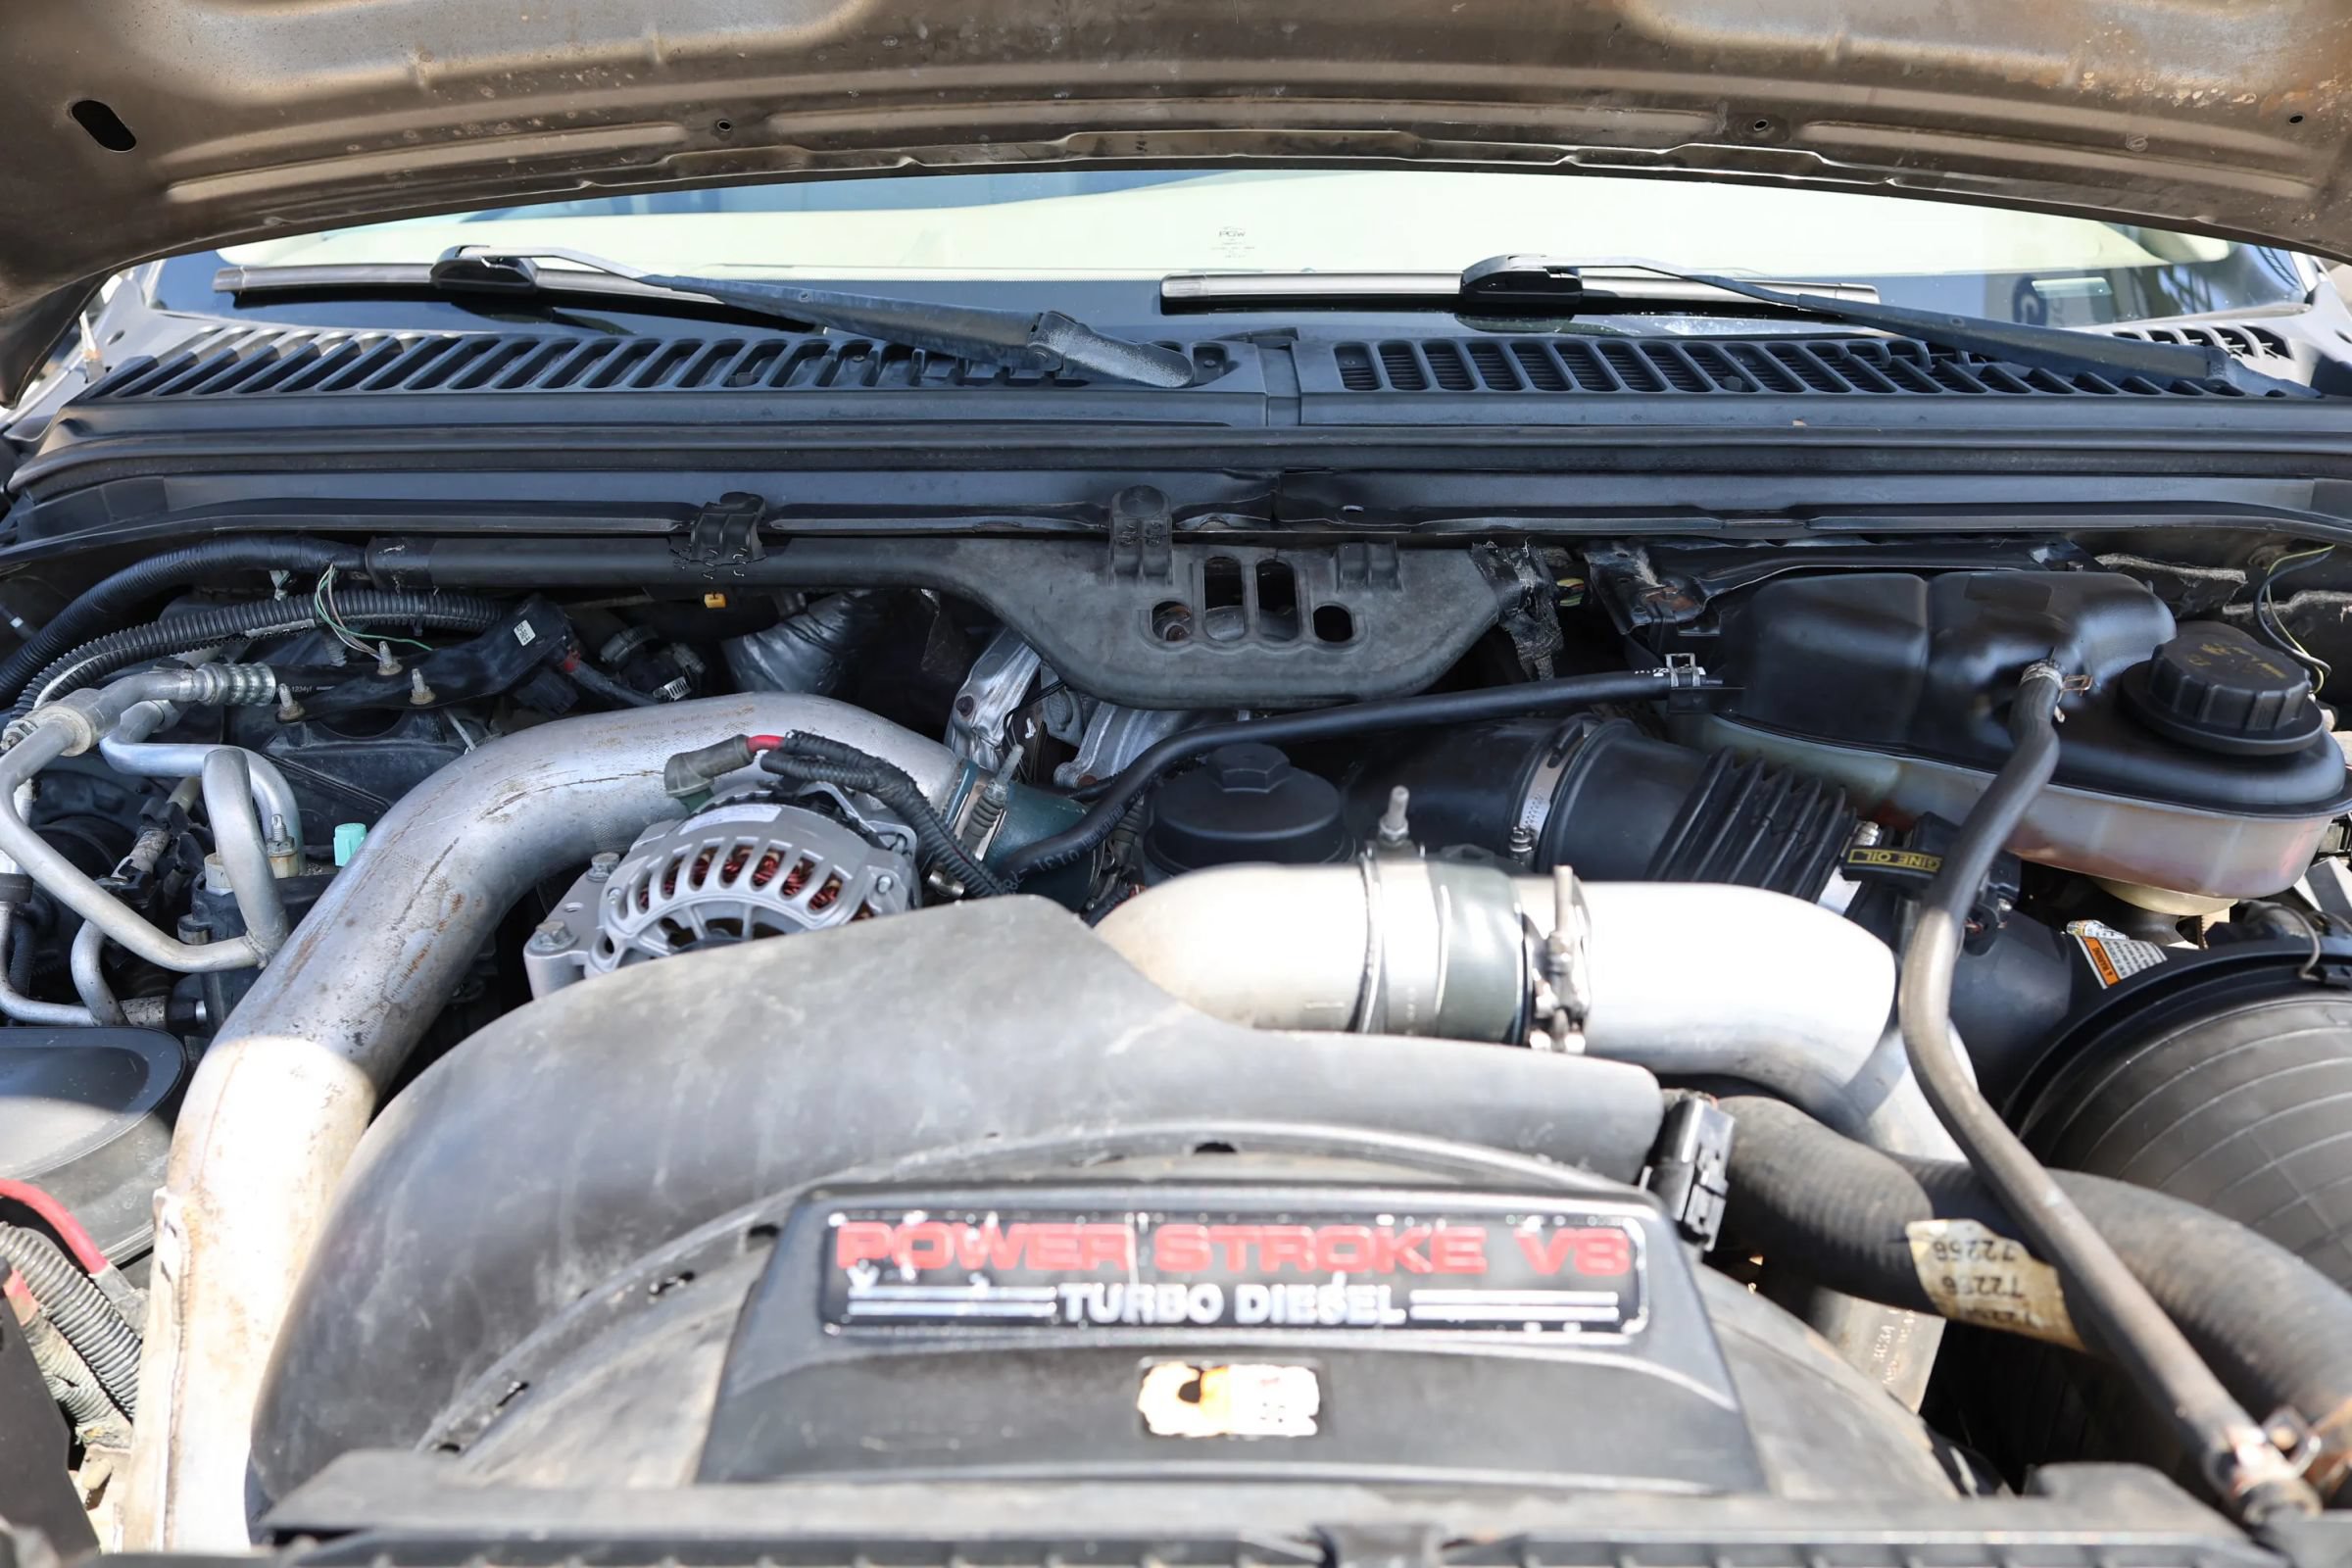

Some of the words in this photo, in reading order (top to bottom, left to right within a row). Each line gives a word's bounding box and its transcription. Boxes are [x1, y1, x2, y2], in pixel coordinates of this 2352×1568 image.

[1865, 852, 1891, 862] OIL
[835, 1220, 1134, 1272] POWER
[1153, 1224, 1487, 1275] STROKE
[1517, 1227, 1632, 1278] V8
[1058, 1282, 1225, 1325] TURBO
[1236, 1283, 1407, 1327] DIESEL
